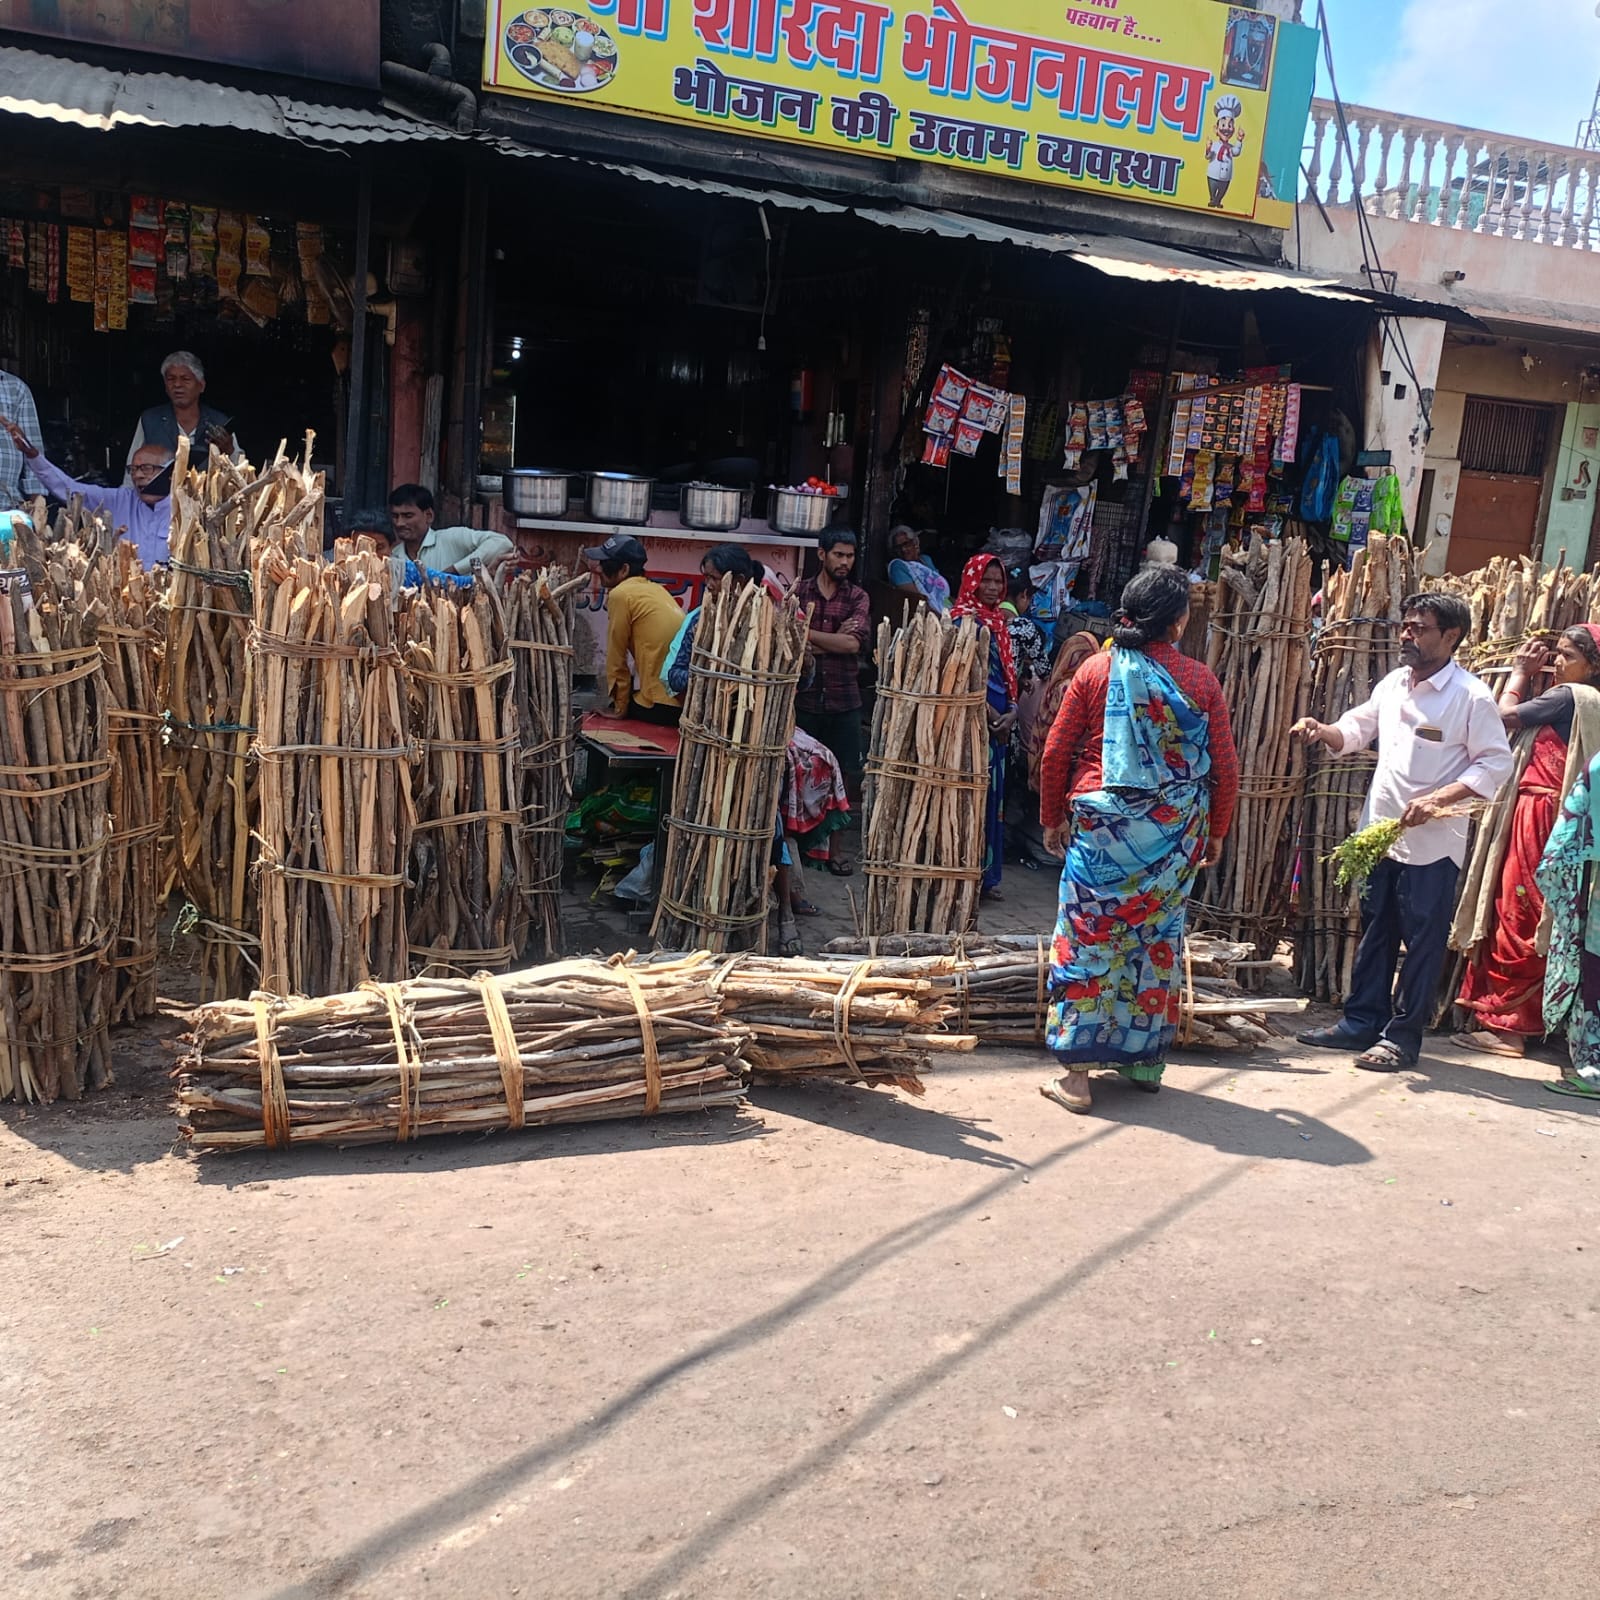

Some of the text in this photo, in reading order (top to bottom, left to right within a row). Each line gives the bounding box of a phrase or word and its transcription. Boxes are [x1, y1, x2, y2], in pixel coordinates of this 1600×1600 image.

[901, 0, 1214, 142] भोजनालय
[1066, 8, 1122, 33] पहचान
[672, 58, 1184, 196] भोजन की उत्तम व्यवस्था
